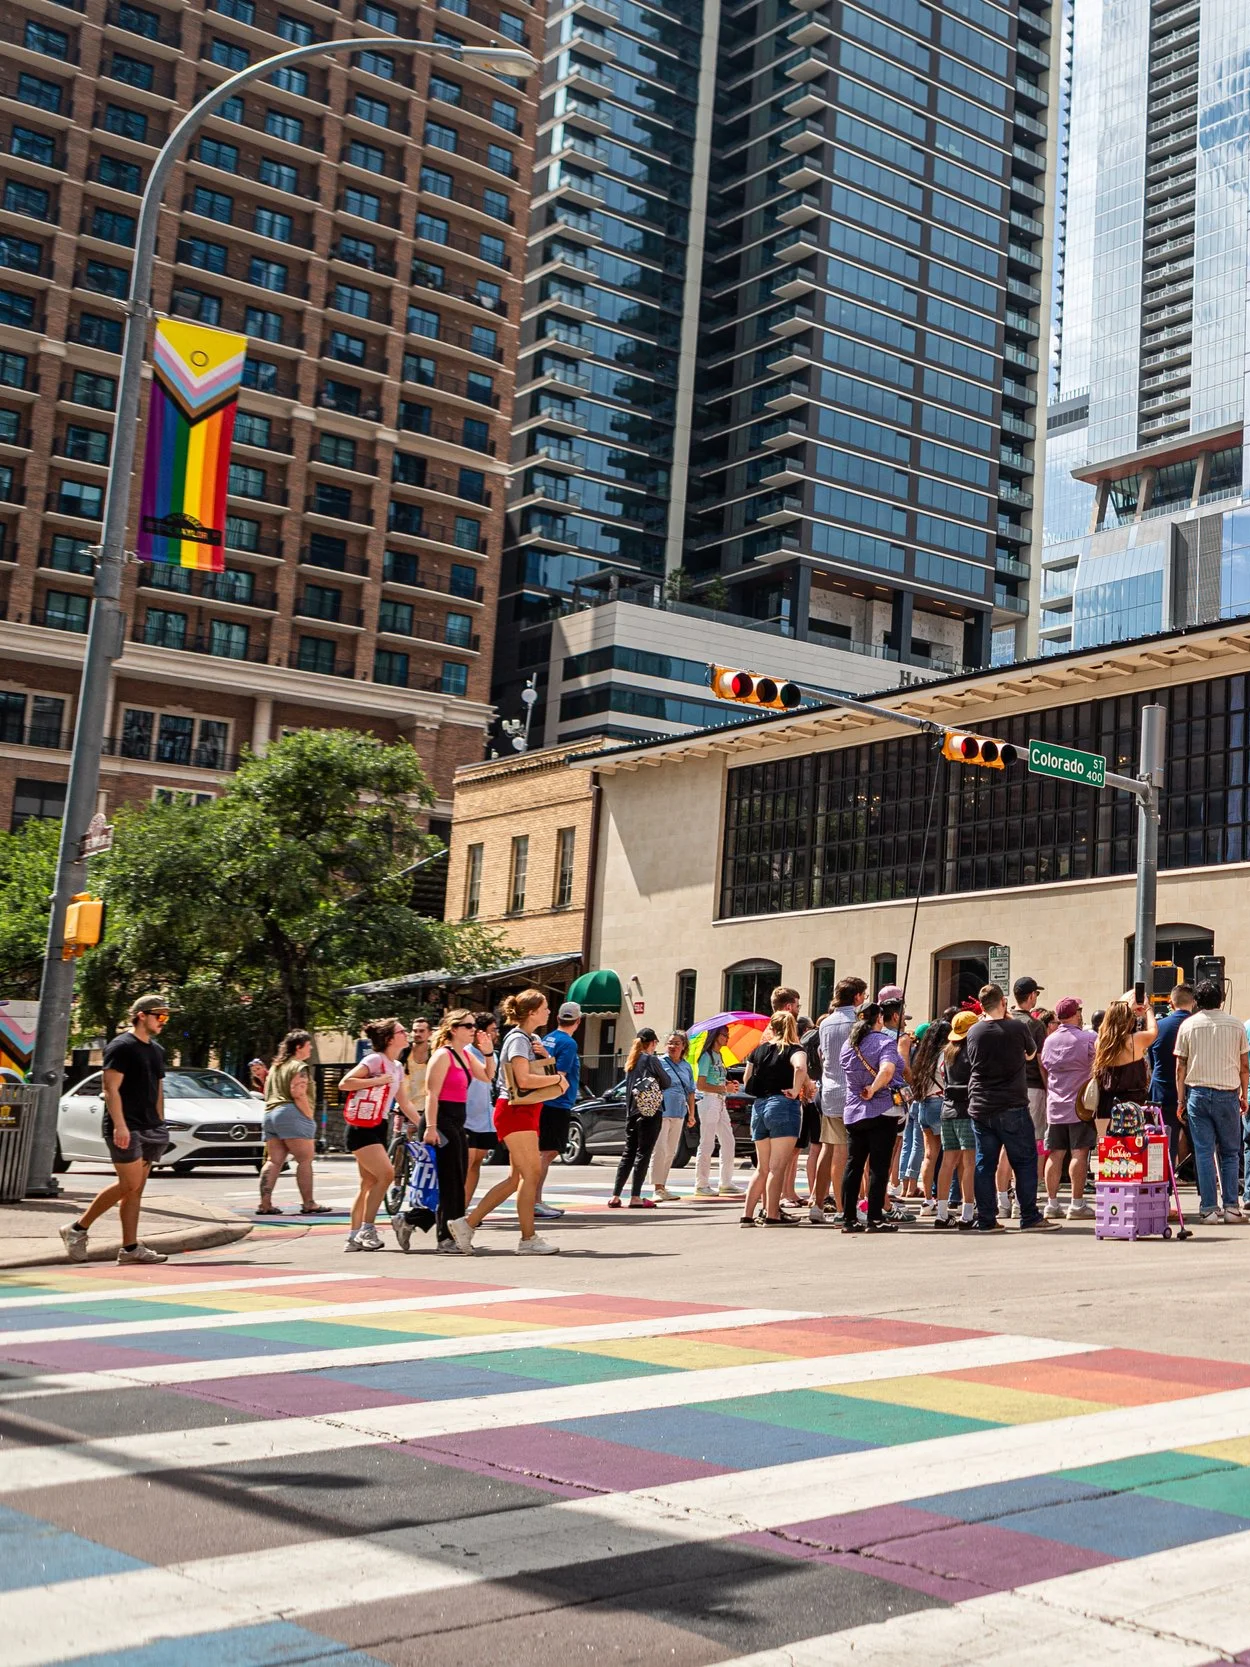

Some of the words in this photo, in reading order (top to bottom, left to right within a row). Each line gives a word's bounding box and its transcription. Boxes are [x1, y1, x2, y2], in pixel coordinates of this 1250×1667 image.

[1031, 748, 1084, 775] Colorado
[1093, 759, 1103, 770] ST
[1086, 770, 1103, 783] 400
